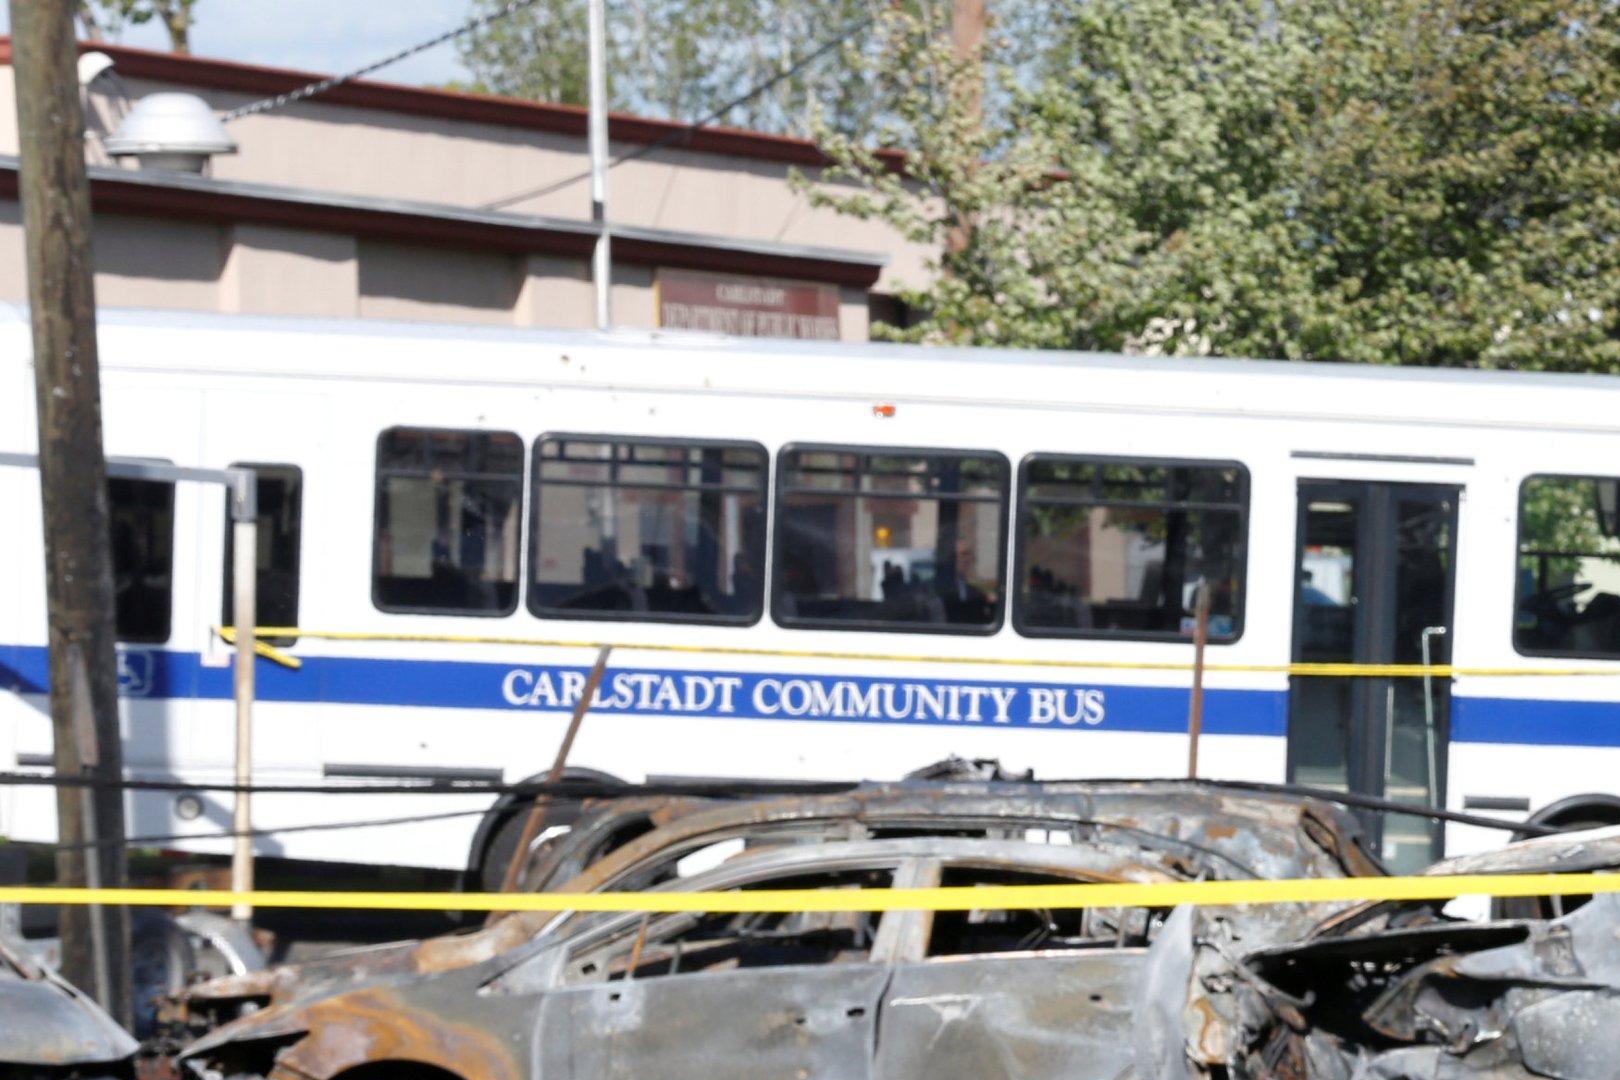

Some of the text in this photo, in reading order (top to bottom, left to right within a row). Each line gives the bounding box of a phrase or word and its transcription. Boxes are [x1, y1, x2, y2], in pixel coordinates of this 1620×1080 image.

[501, 669, 1106, 726] CARLSTADT COMMUNITY BUS
